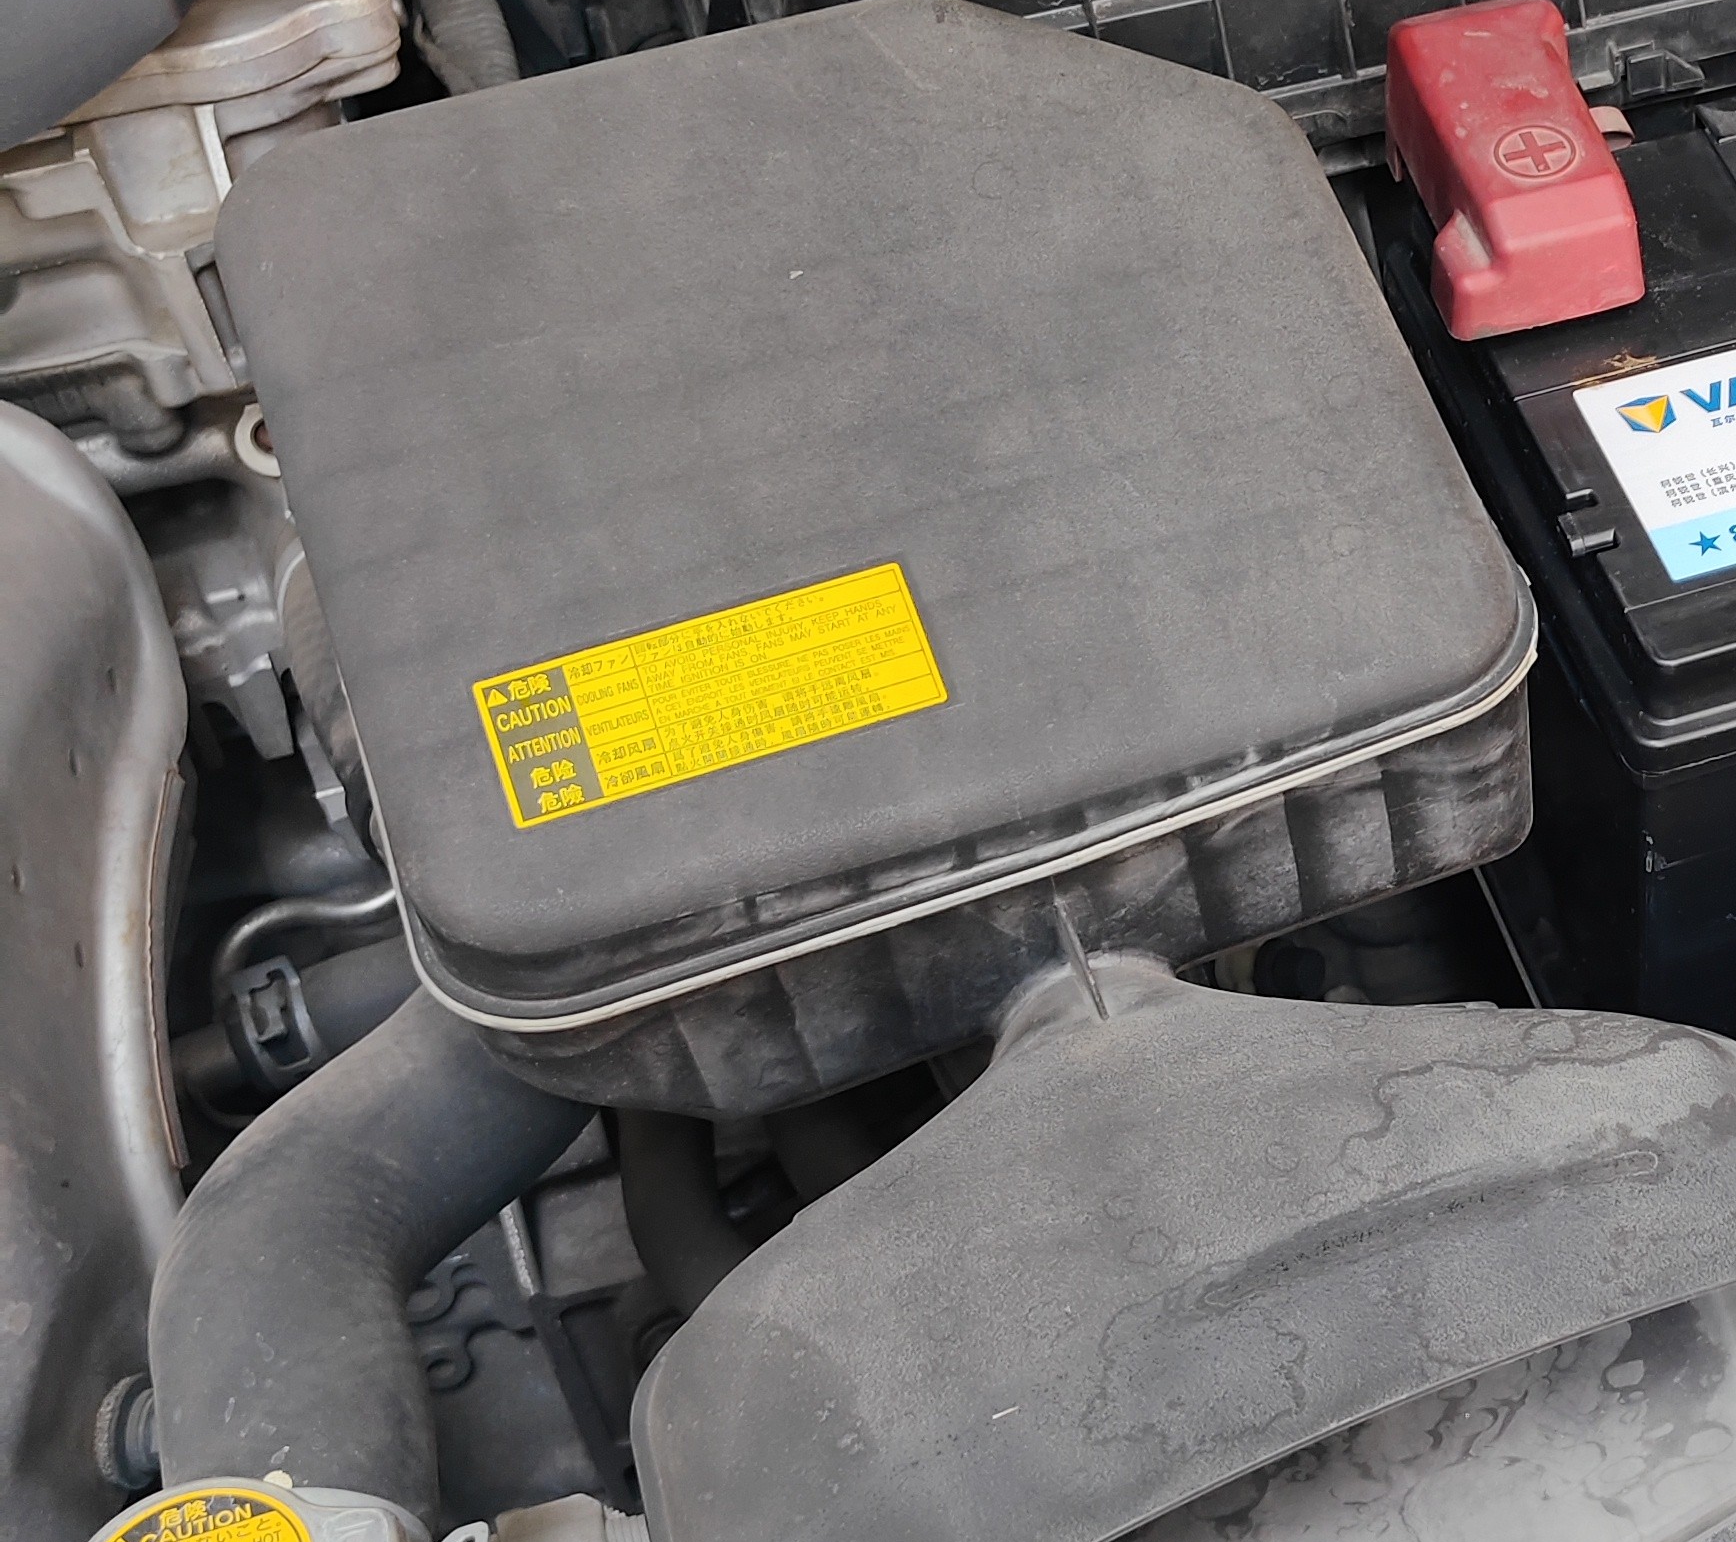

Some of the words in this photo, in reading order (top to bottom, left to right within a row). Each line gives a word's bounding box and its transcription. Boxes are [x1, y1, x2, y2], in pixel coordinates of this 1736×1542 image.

[641, 663, 658, 675] TO
[663, 652, 696, 669] AVOID
[701, 634, 761, 658] PERSONAL
[811, 610, 839, 626] KEEP
[844, 598, 882, 617] HANDS
[645, 668, 675, 684] AWAY
[680, 656, 714, 674] FROM
[755, 636, 784, 652] FANS
[788, 628, 811, 642] MAY
[816, 616, 851, 634] START
[856, 611, 869, 623] AT
[874, 603, 896, 618] ANY
[575, 685, 614, 706] COOLING
[615, 677, 639, 694] FANS
[647, 678, 674, 693] TIME
[679, 662, 729, 684] IGNITION
[733, 658, 745, 668] IS
[496, 695, 571, 732] CAUTION
[585, 708, 650, 736] VENTILATEURS
[508, 726, 581, 763] ATTENTION
